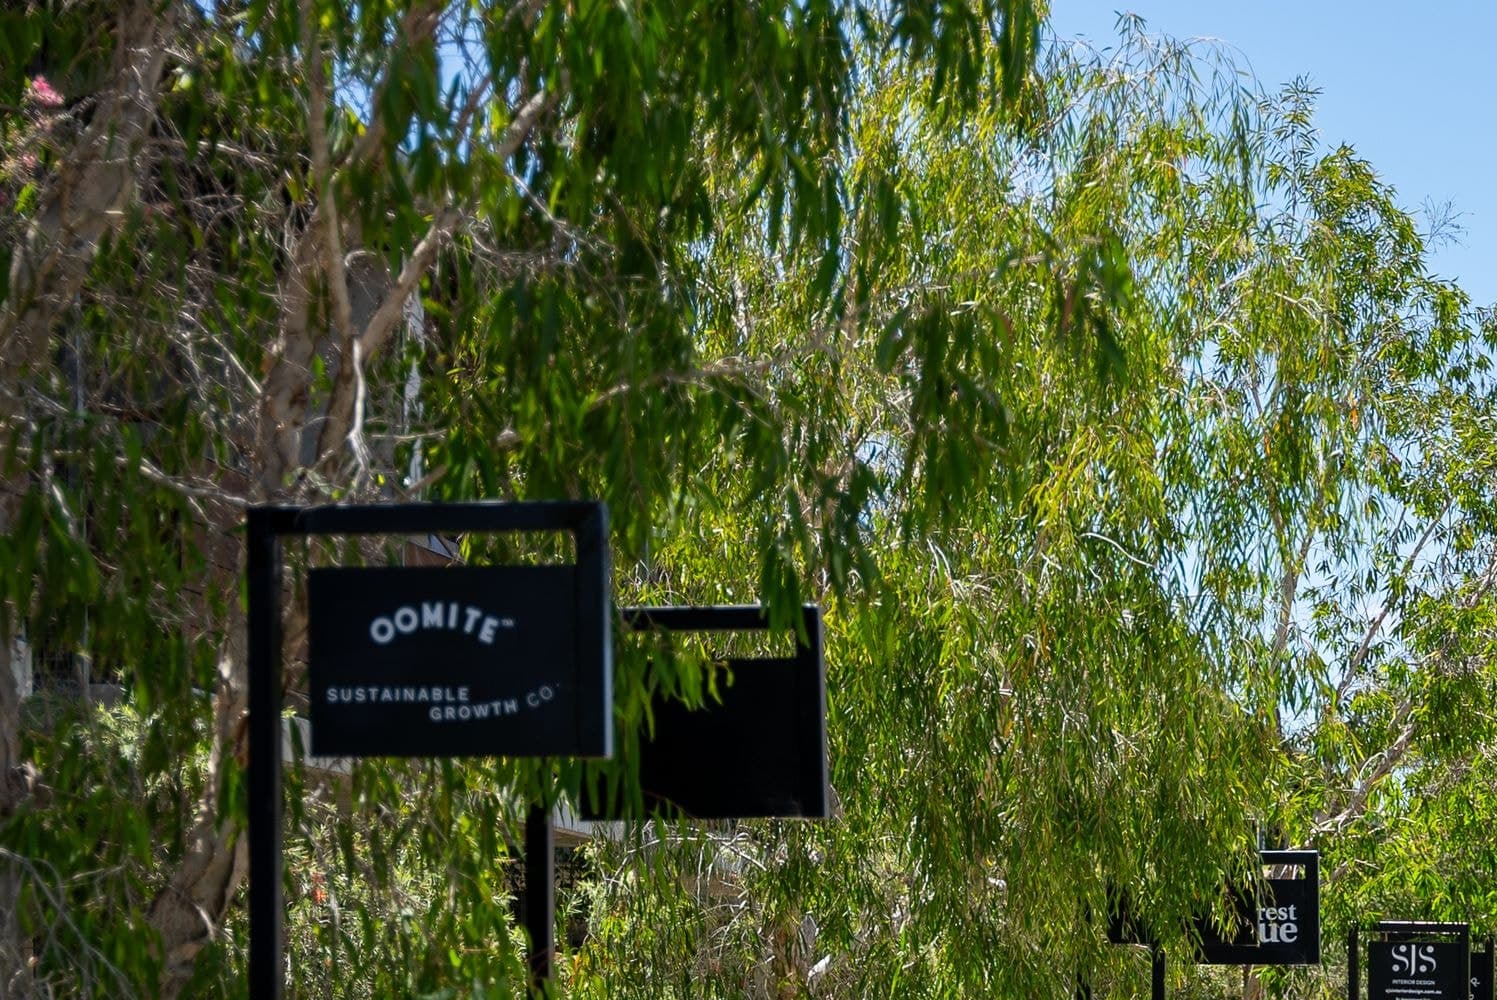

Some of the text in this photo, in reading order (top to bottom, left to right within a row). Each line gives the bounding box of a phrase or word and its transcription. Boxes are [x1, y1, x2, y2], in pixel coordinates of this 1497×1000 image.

[327, 687, 470, 703] SUSTAINABLE
[429, 699, 518, 721] GROWTH
[1256, 904, 1298, 920] rest
[1258, 922, 1298, 943] ue
[1391, 944, 1437, 976] SJS
